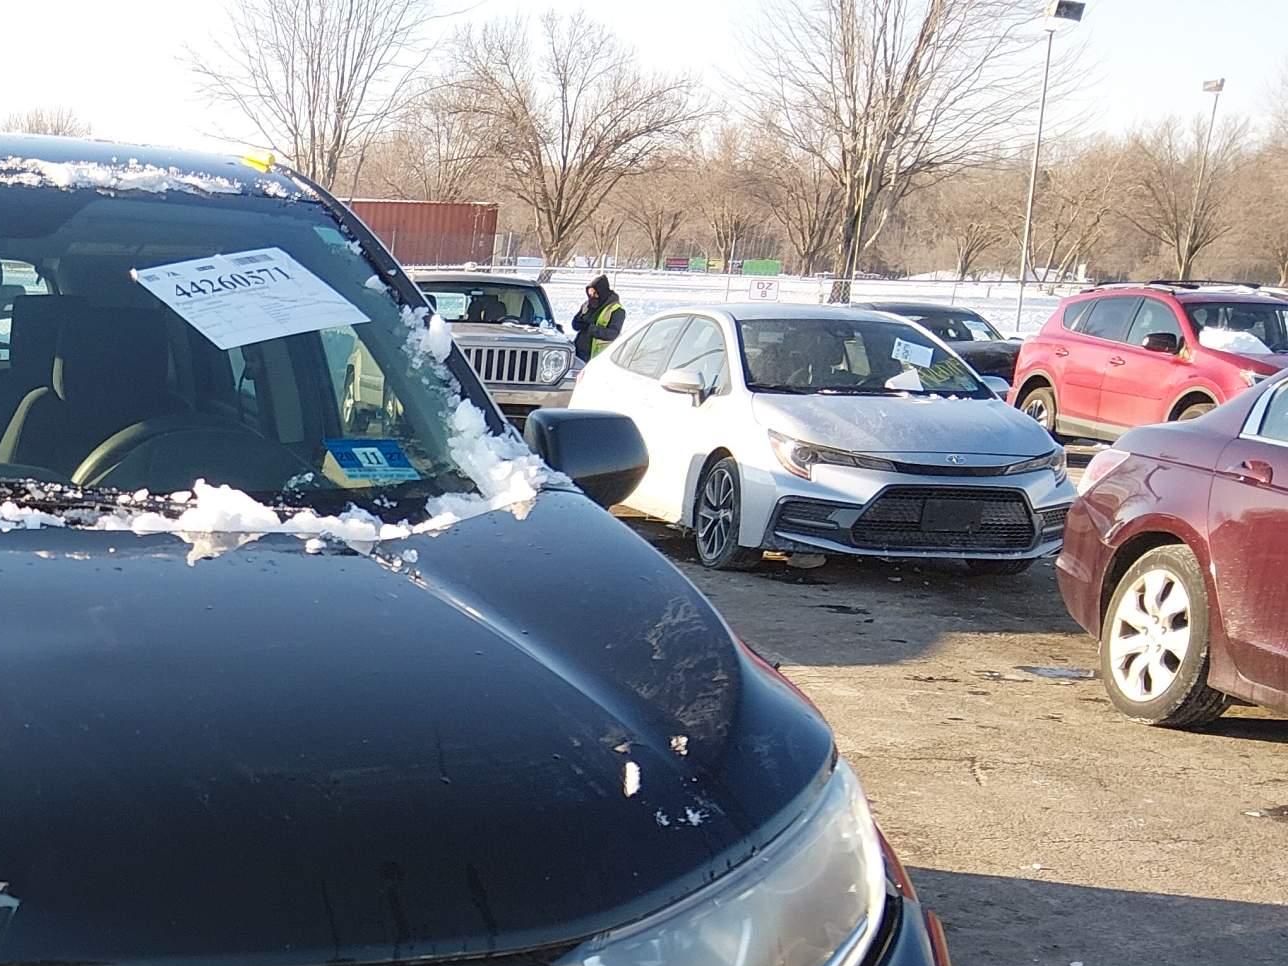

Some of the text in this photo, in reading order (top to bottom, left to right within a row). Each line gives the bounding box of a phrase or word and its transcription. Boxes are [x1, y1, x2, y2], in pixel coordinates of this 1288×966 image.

[175, 266, 295, 298] 44260571
[756, 282, 774, 291] DZ
[760, 290, 767, 298] 8
[362, 451, 383, 465] 11
